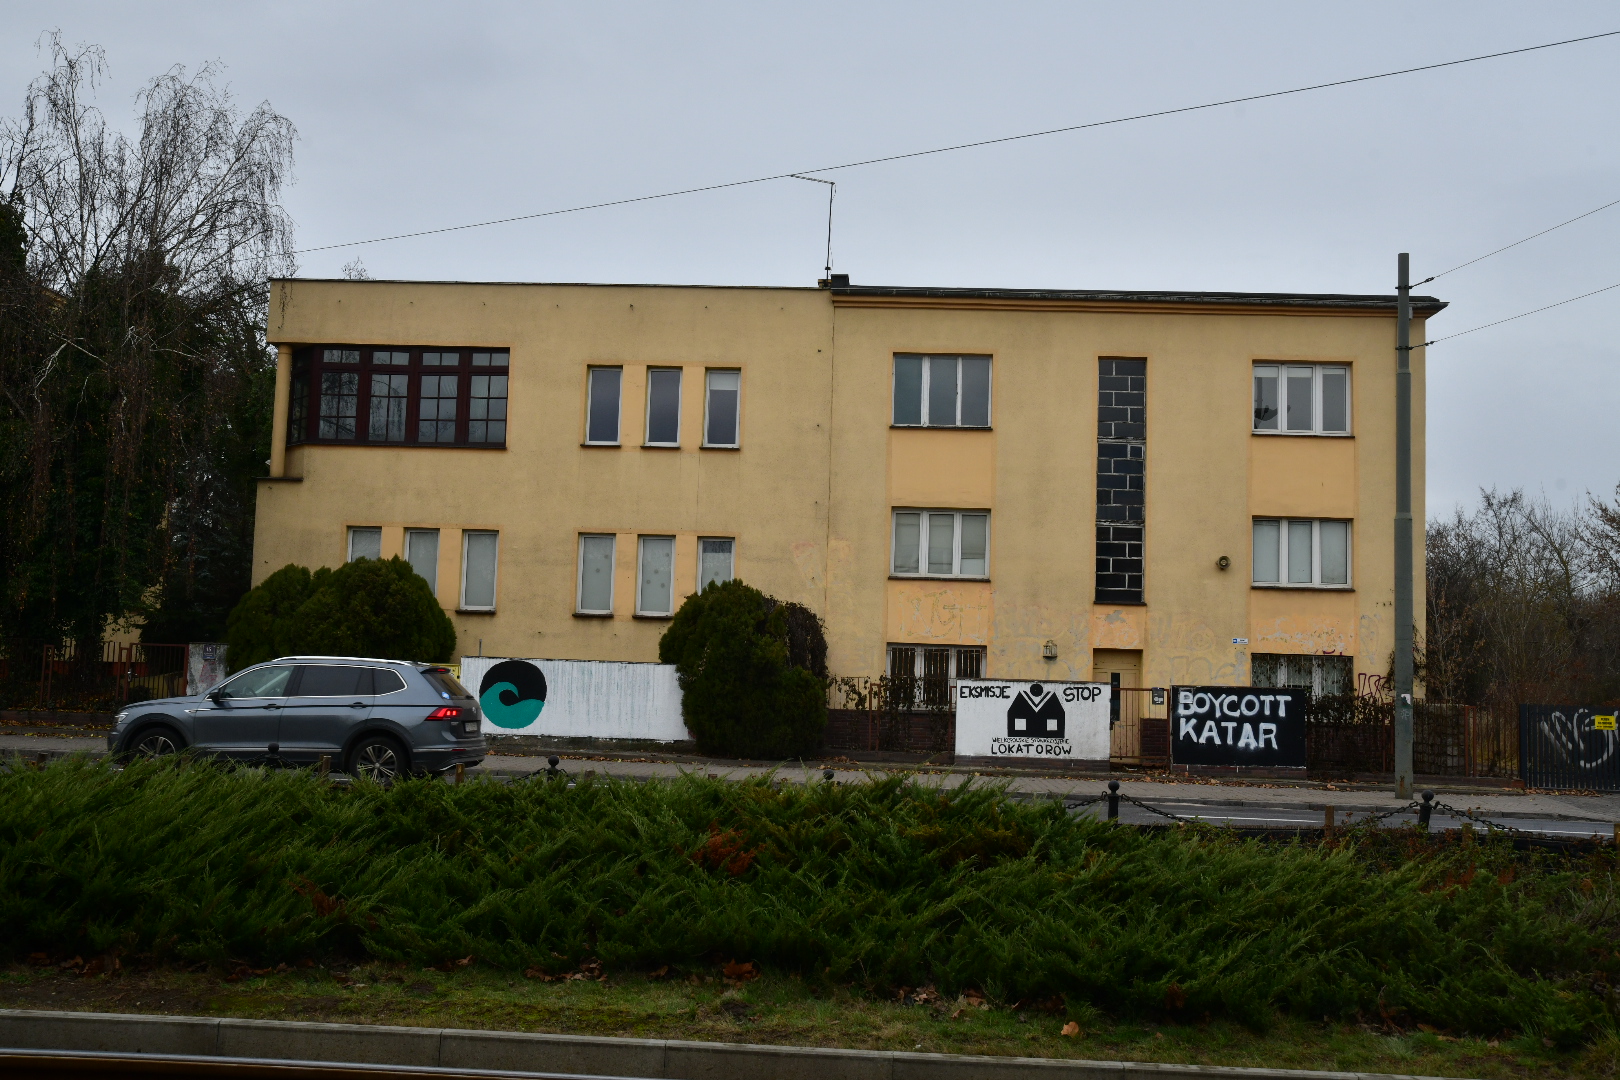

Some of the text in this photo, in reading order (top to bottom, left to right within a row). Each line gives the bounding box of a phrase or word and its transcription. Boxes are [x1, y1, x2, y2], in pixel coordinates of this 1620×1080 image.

[960, 685, 1102, 703] EKSMISJE STOP
[1178, 691, 1292, 719] BOYCOTT
[1180, 717, 1278, 750] KATAR
